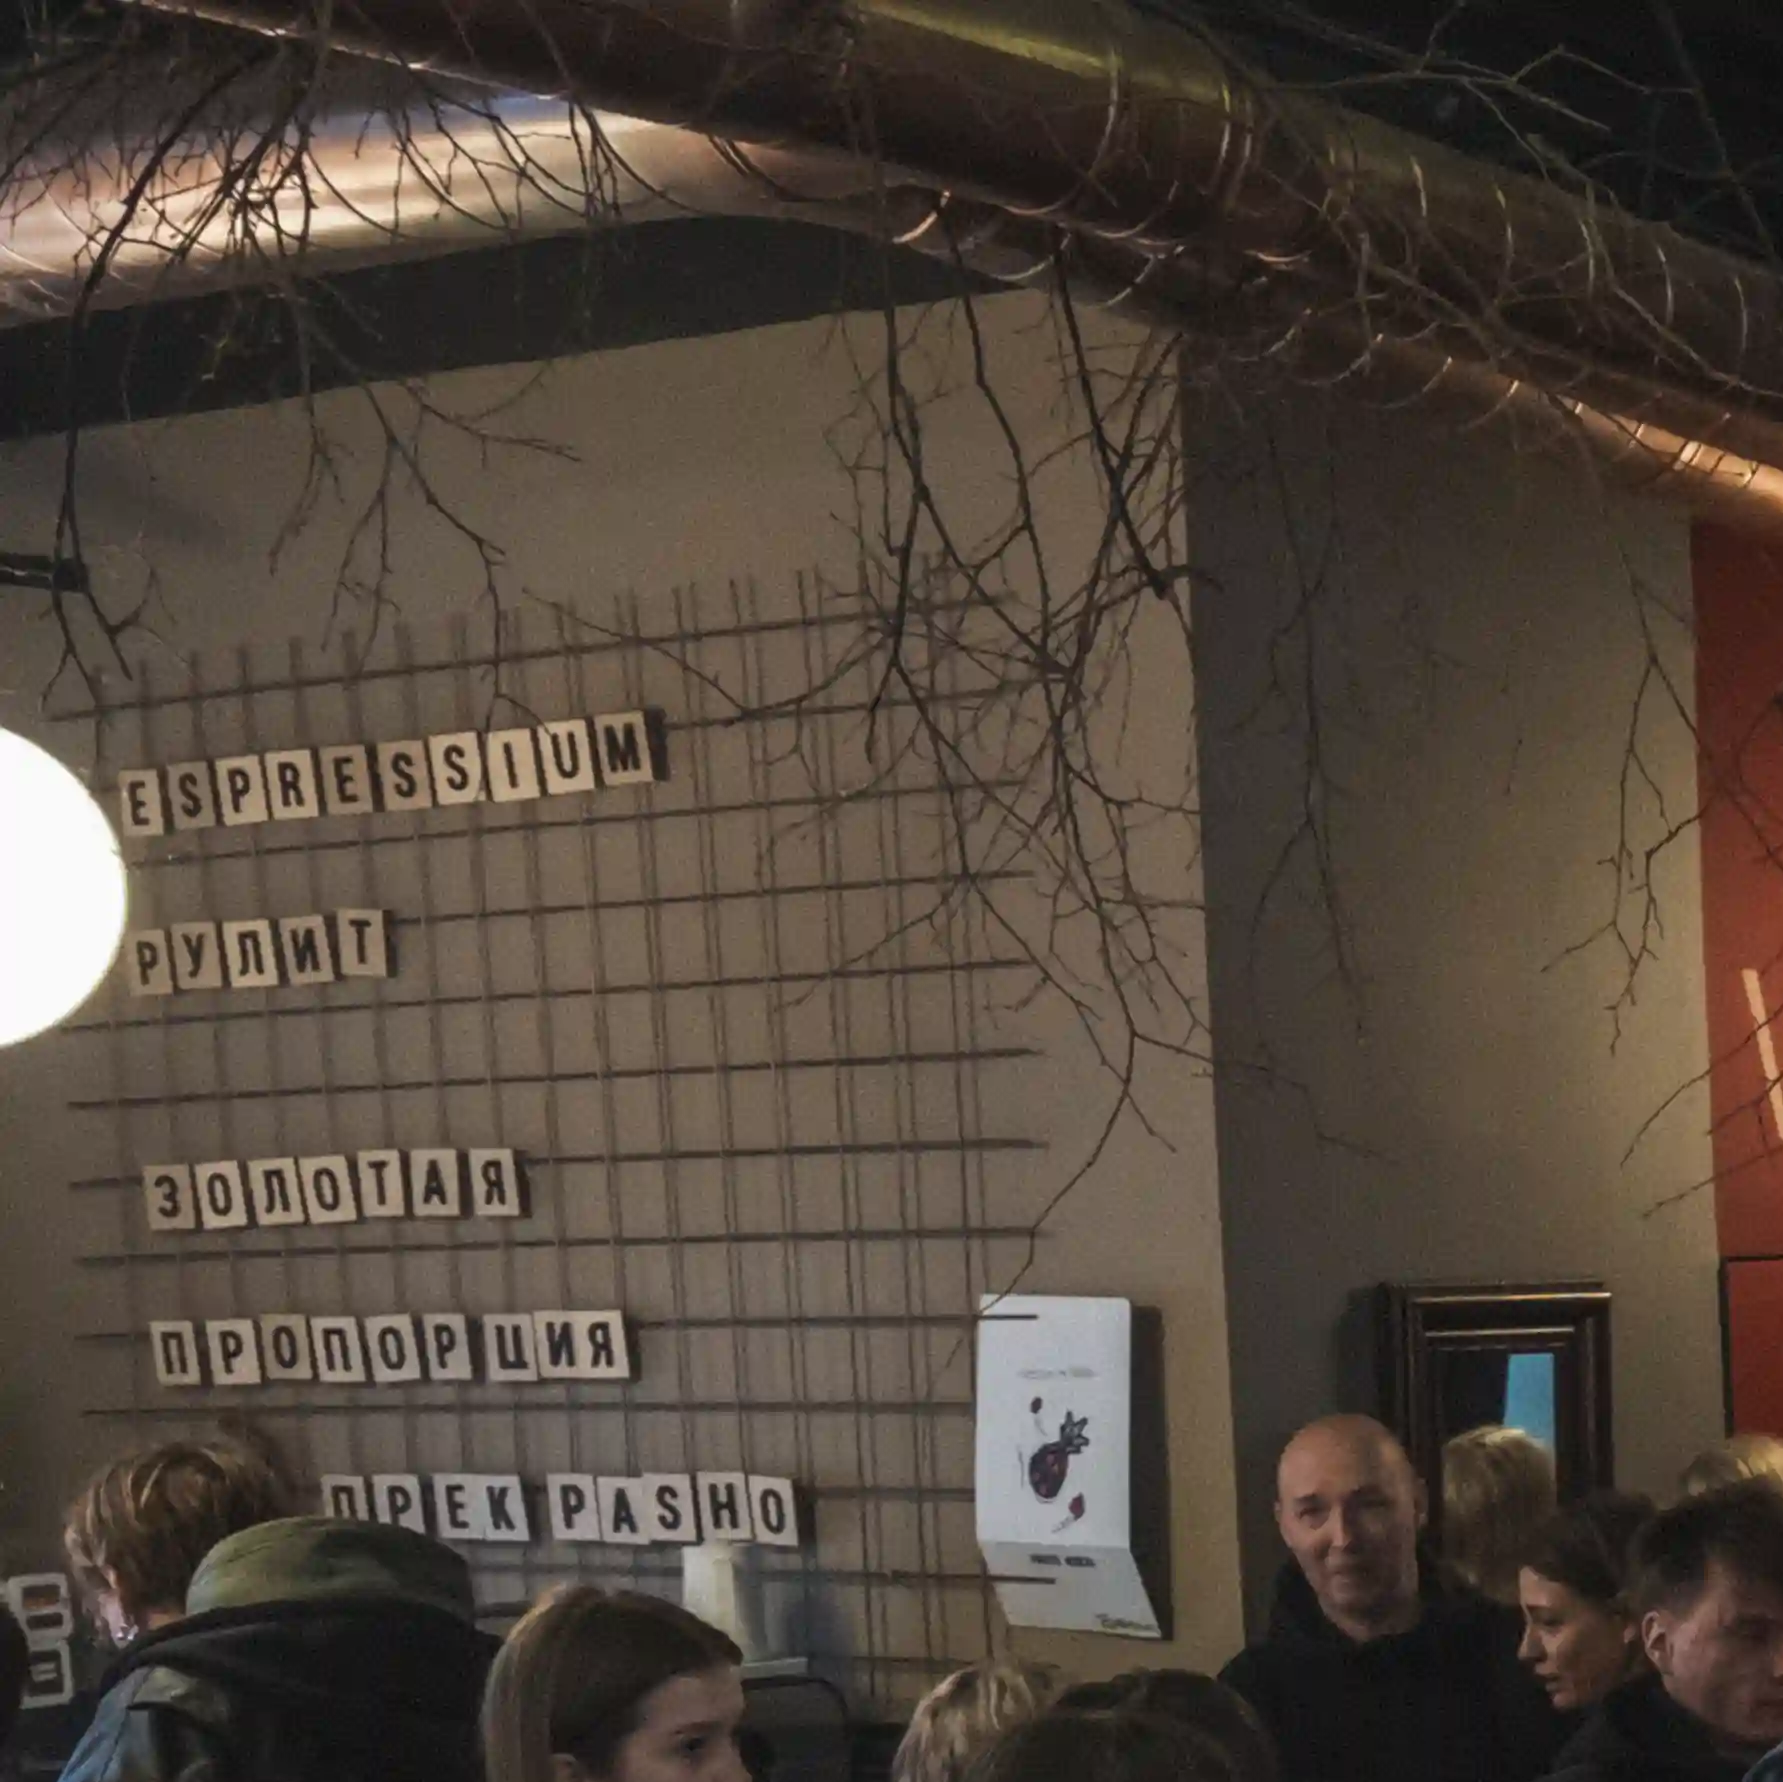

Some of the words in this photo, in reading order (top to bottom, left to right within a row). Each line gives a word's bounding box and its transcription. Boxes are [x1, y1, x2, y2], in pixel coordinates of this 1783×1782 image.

[127, 721, 643, 828] ESPRESSIUM
[136, 917, 373, 986] РУЛИТ
[152, 1158, 508, 1220] ЗОЛОТАЯ
[159, 1319, 616, 1377] ПРОПОРЦИЯ
